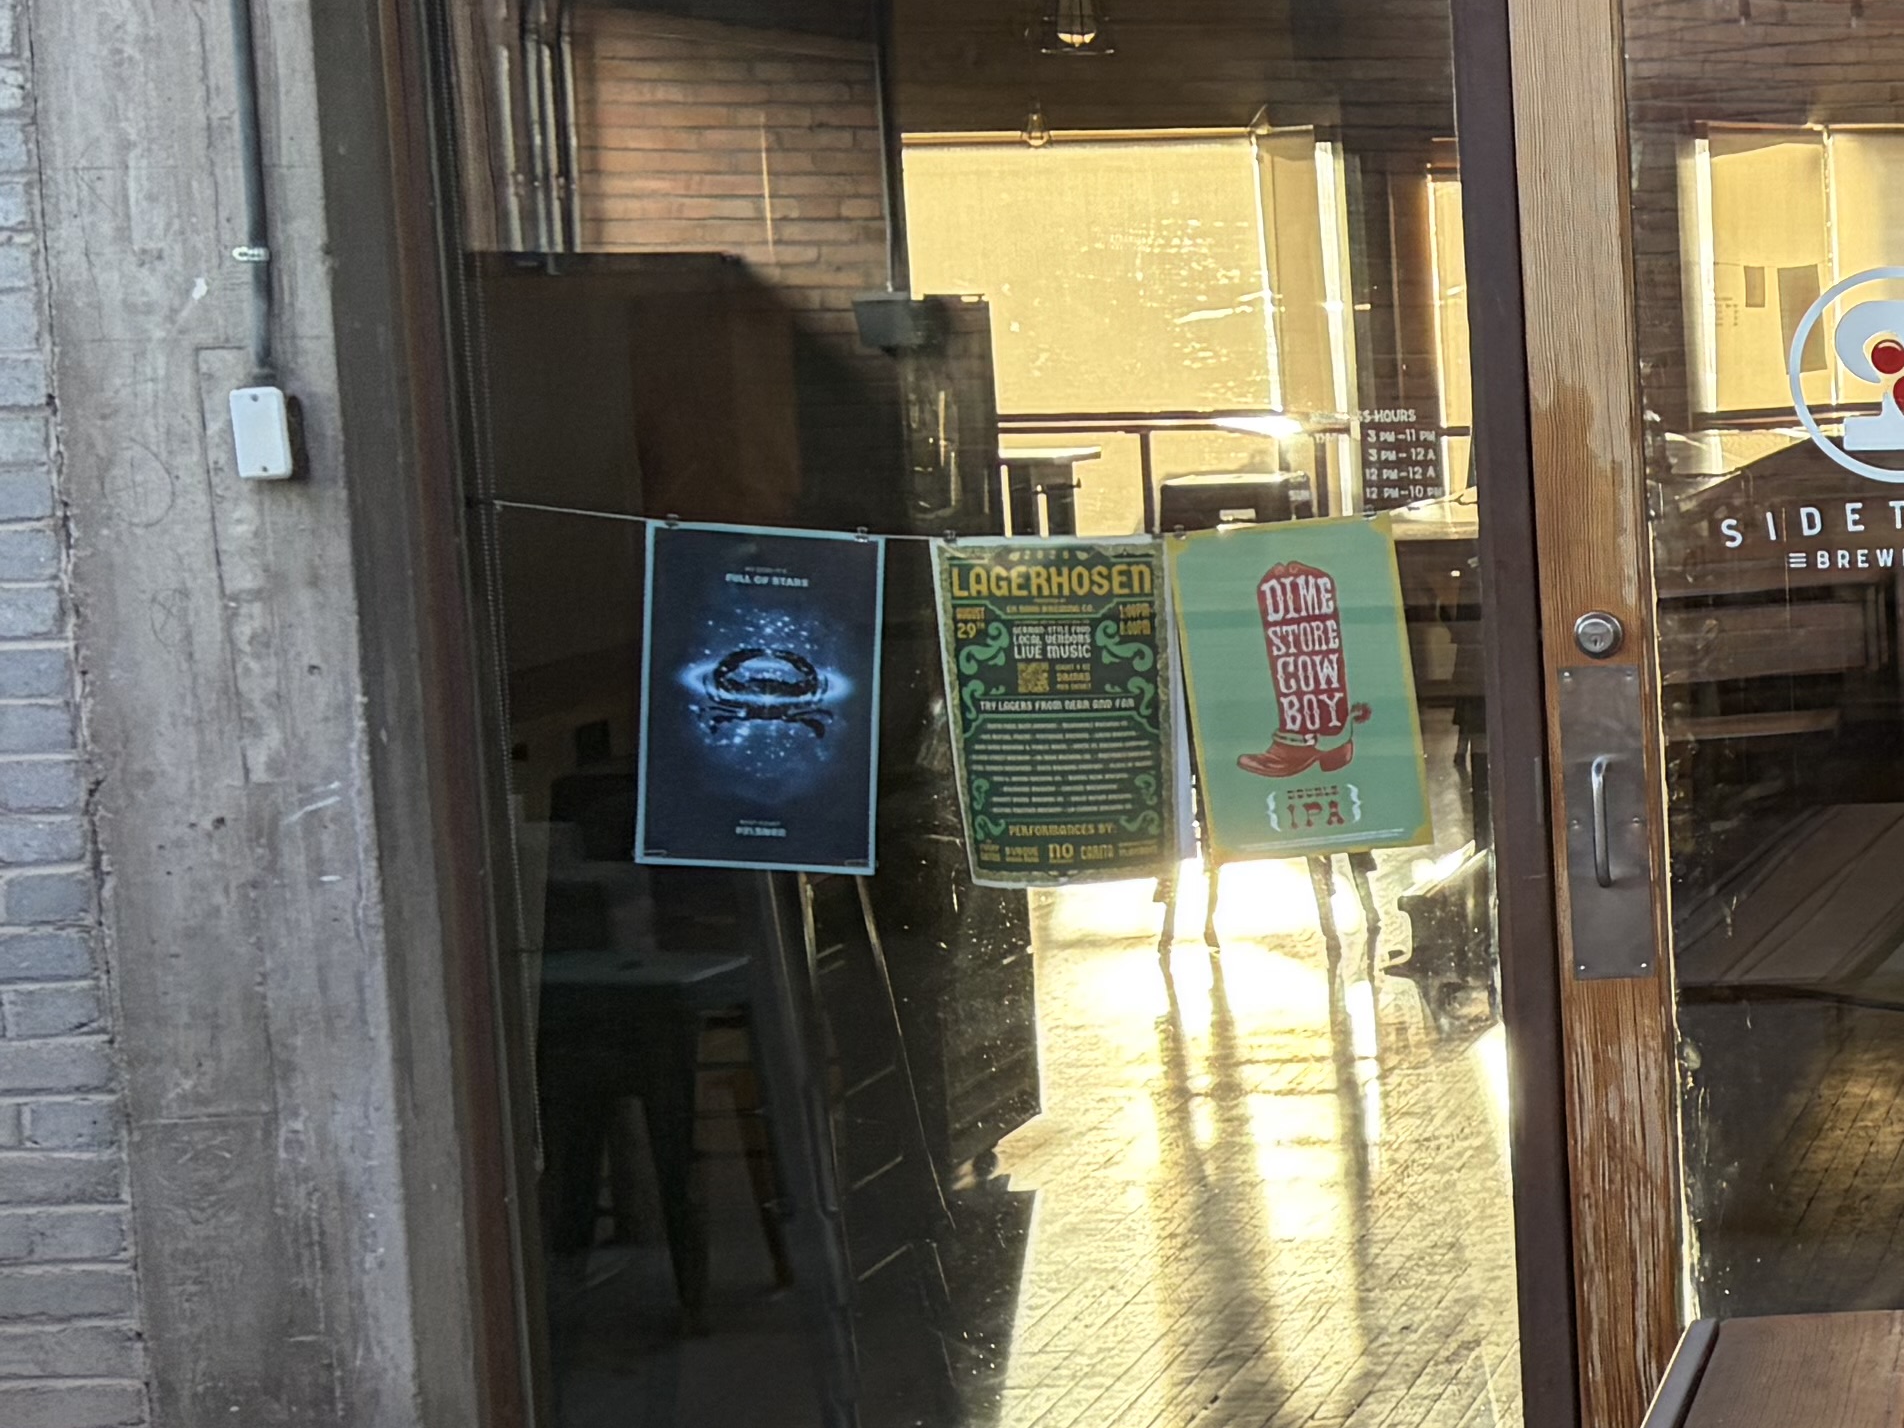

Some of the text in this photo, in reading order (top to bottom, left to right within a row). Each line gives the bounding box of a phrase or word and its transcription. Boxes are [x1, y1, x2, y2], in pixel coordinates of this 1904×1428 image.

[951, 563, 1151, 598] LAGERHOSEN
[1261, 575, 1335, 622] DIME
[1014, 644, 1092, 659] LIVE MUSIC
[1268, 620, 1340, 656] STORE
[1277, 653, 1340, 694] COW
[1280, 692, 1344, 731] BOY
[1286, 800, 1345, 830] IPA
